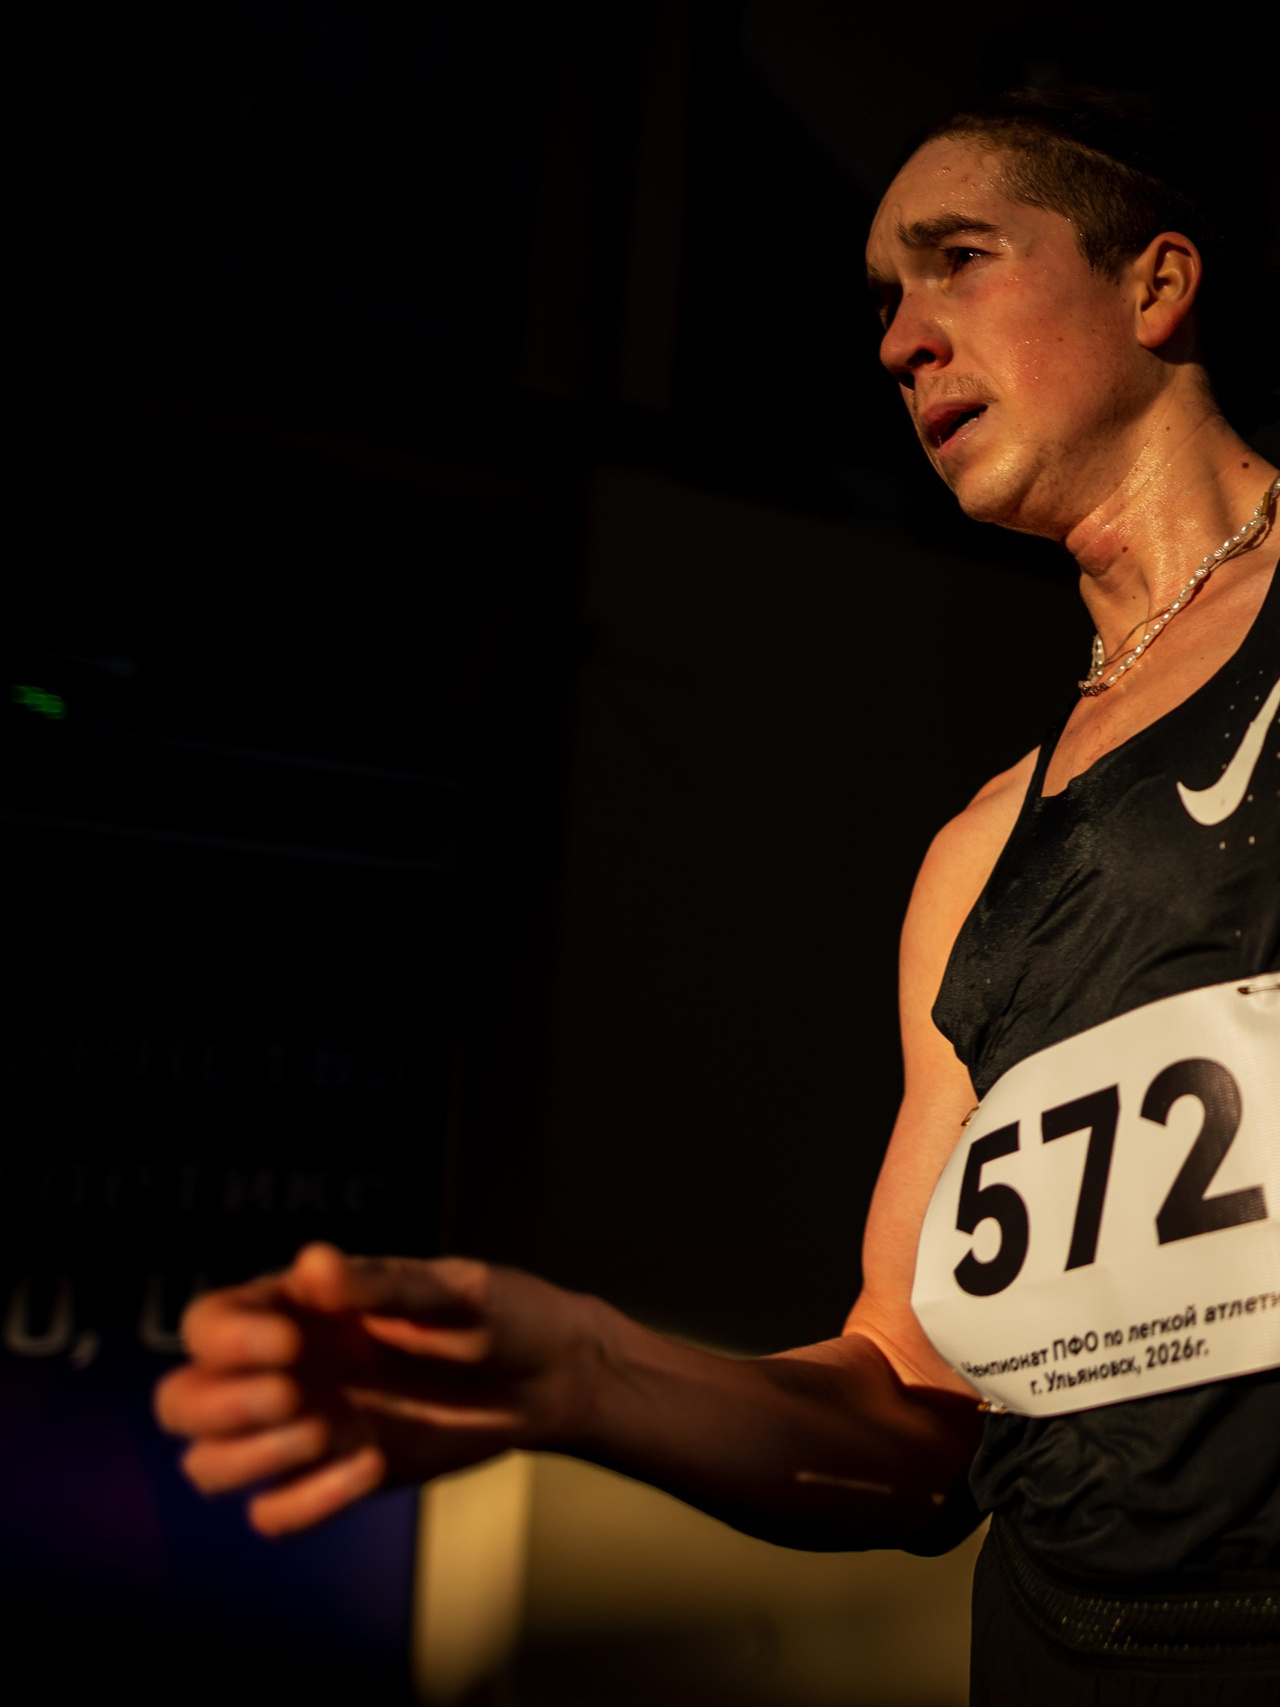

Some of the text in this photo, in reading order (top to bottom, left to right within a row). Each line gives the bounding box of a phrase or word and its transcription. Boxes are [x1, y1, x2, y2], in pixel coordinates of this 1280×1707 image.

[953, 1056, 1268, 1297] 572
[1053, 1330, 1099, 1361] ПФО
[1104, 1329, 1124, 1348] по
[1127, 1304, 1197, 1342] легкой
[1030, 1337, 1209, 1396] г. Ульяновск, 2026г.
